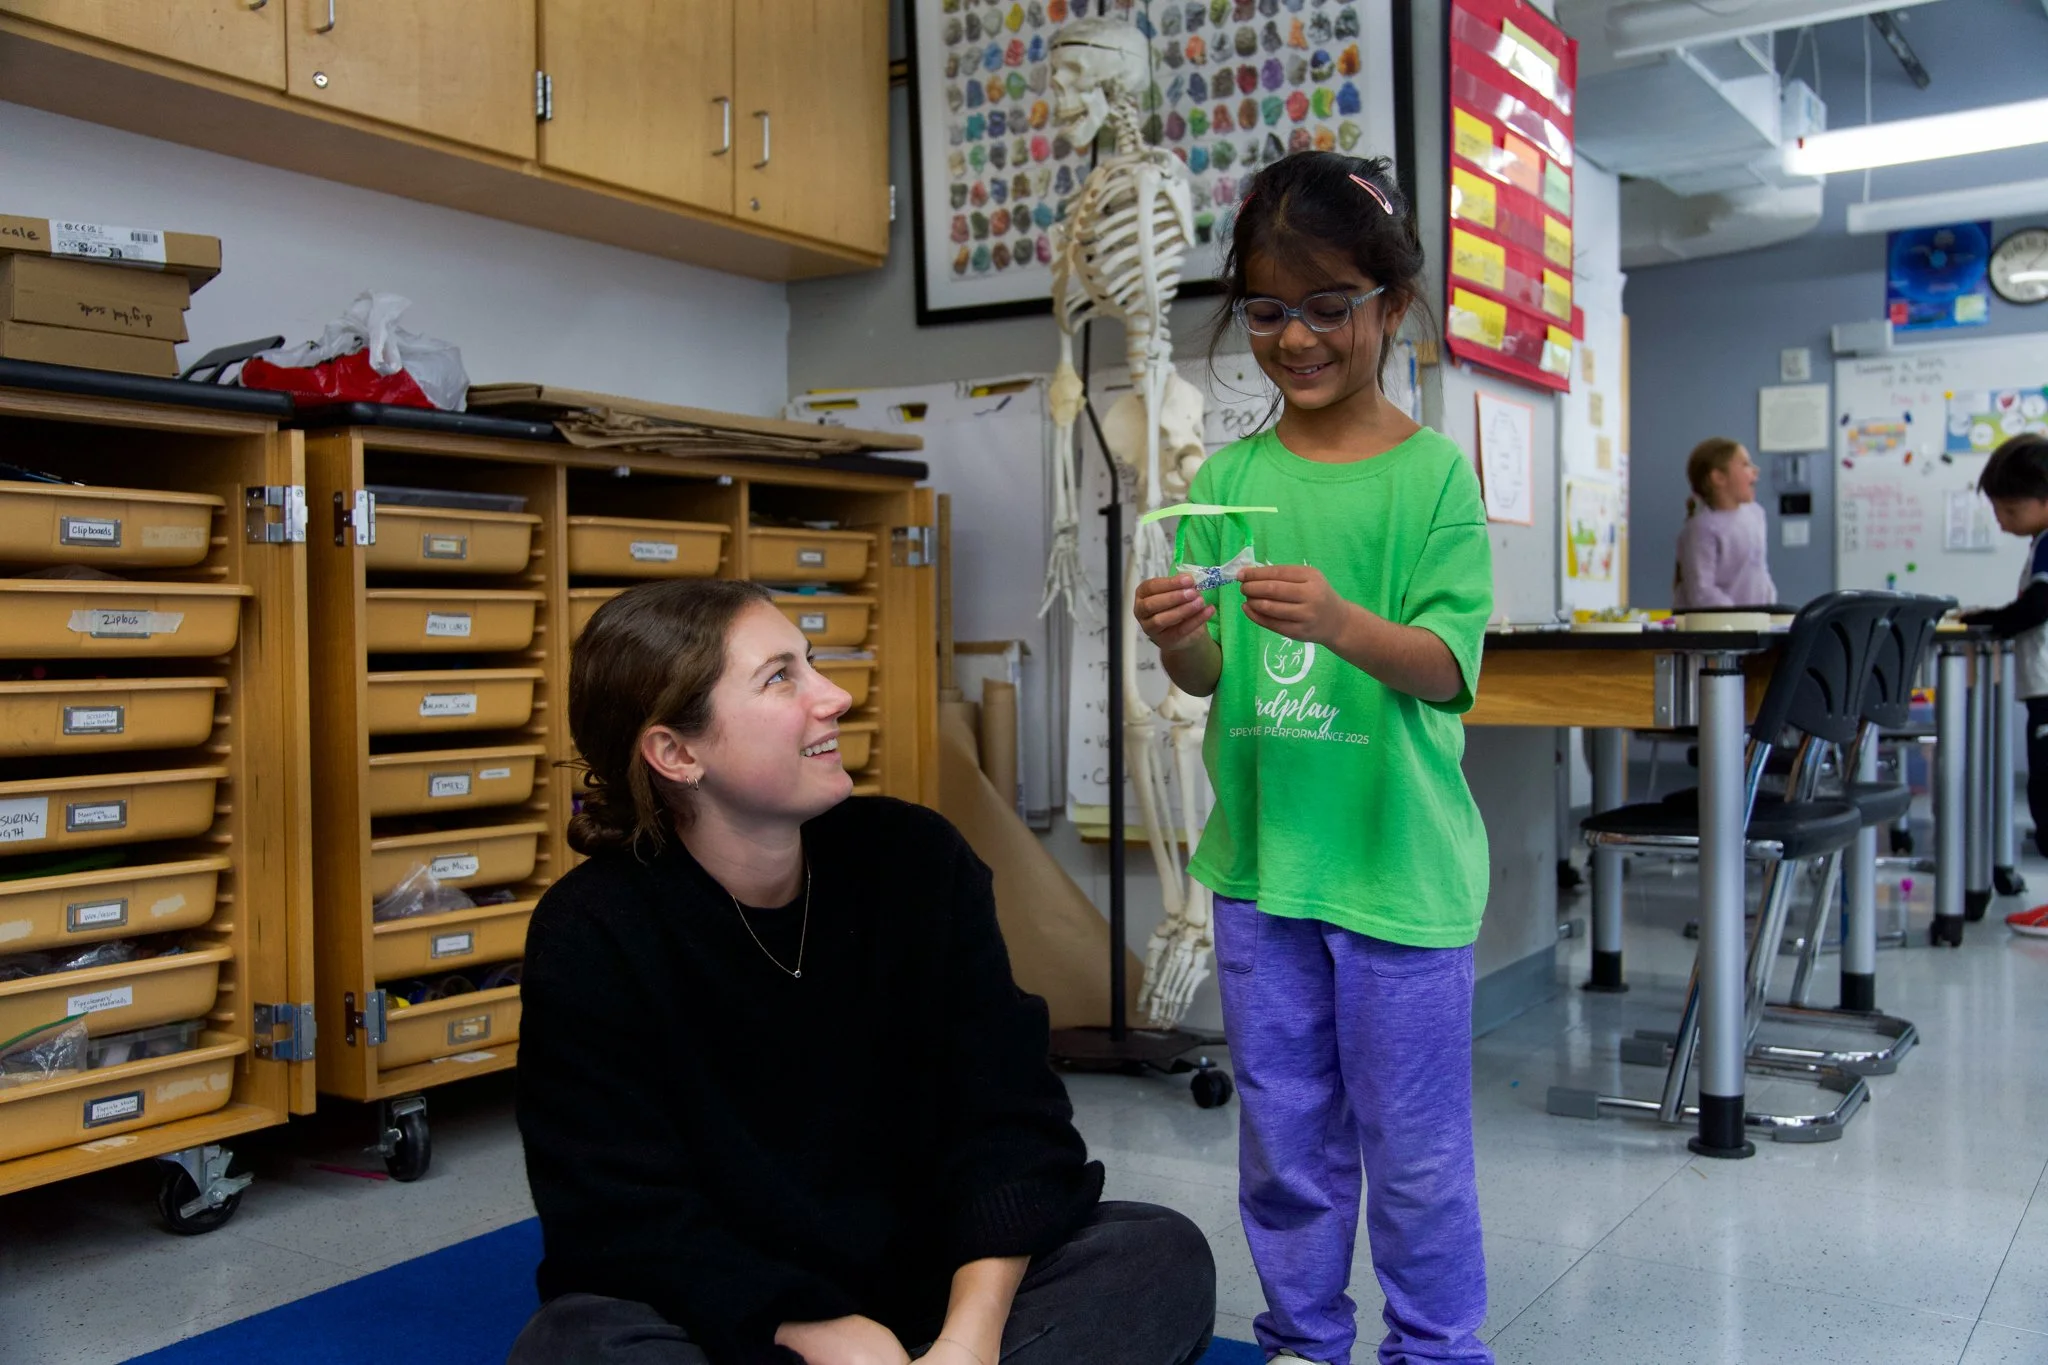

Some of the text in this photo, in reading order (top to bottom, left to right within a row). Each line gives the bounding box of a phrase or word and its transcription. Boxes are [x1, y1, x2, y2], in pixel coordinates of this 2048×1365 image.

[77, 301, 153, 328] digital scale
[72, 525, 112, 537] Clipboards
[1255, 685, 1340, 734] rdplay
[1263, 726, 1344, 742] PERFORMANCE
[1345, 732, 1370, 745] 2025
[0, 827, 25, 839] GTH
